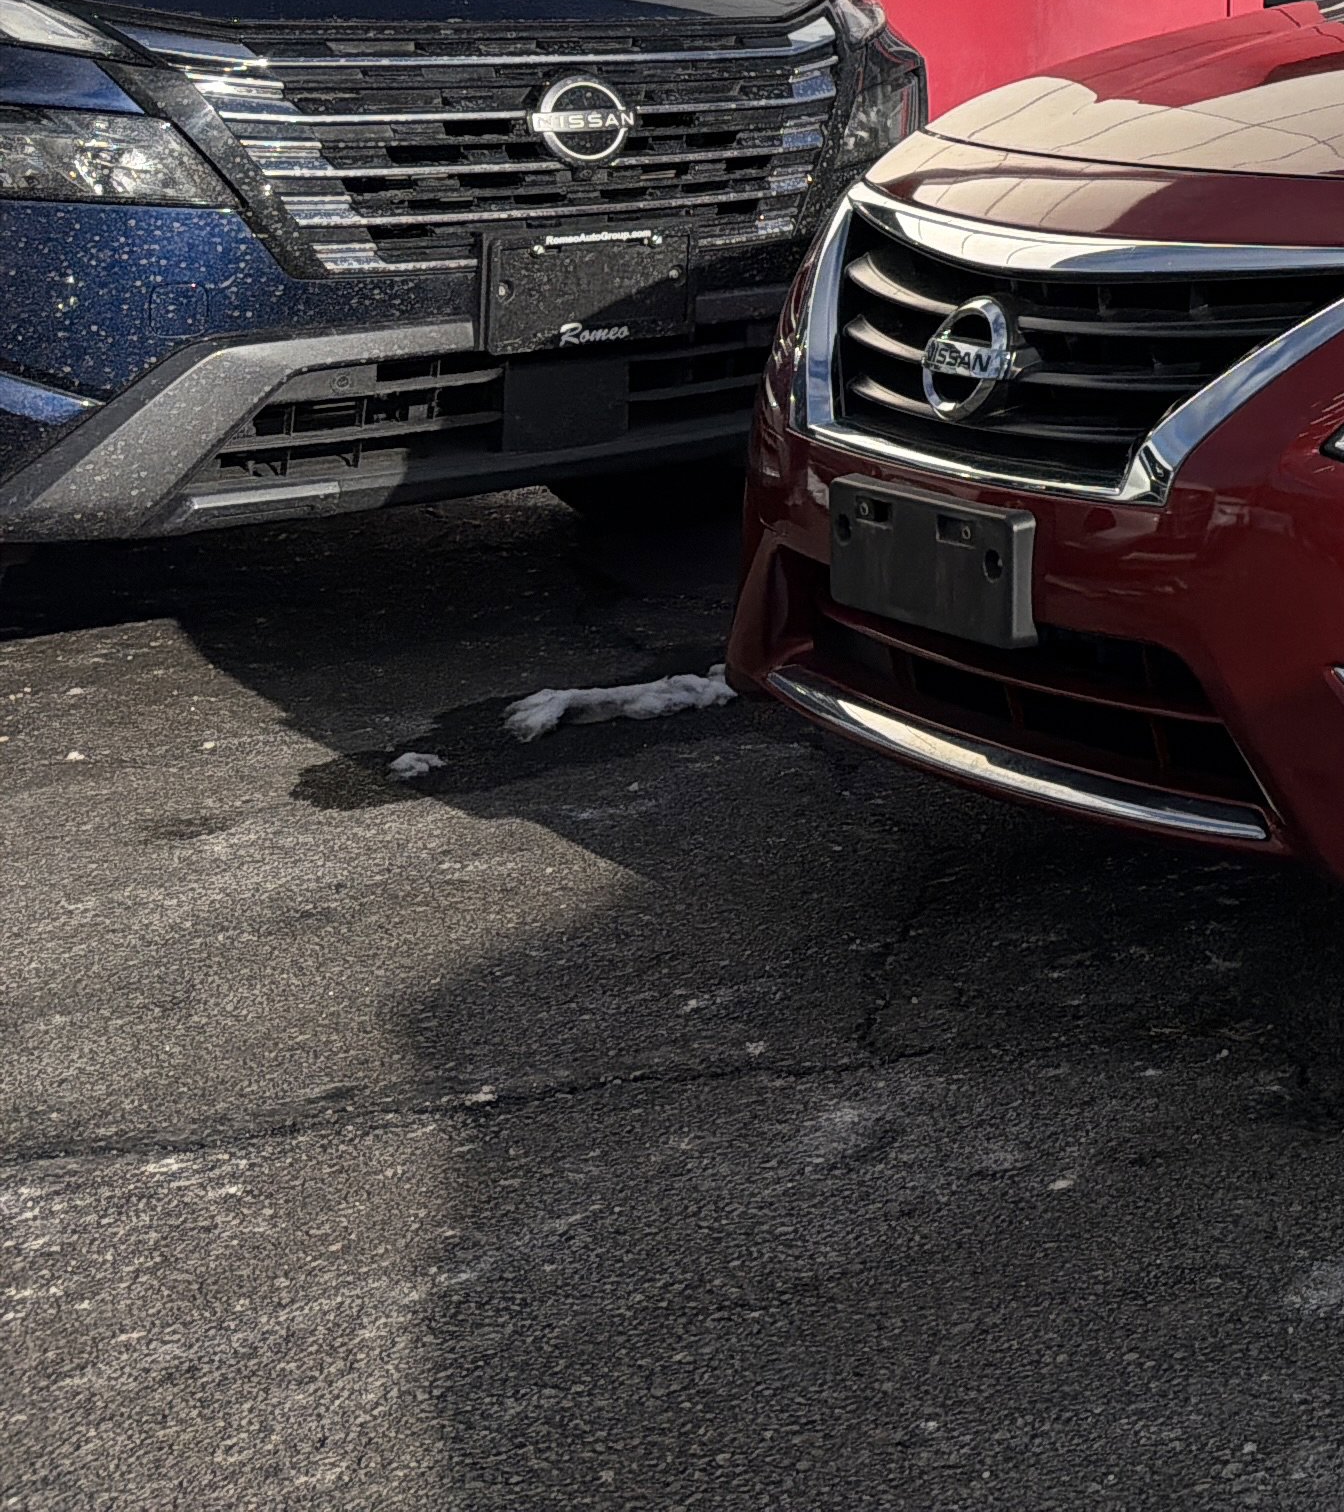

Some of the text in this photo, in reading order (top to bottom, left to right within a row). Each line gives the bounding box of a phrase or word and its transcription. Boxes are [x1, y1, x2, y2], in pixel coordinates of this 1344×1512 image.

[537, 112, 635, 129] NISSAN
[545, 229, 652, 246] RomeoAutoGroup.com
[559, 322, 630, 347] Romeo
[926, 340, 992, 373] NISSAN
